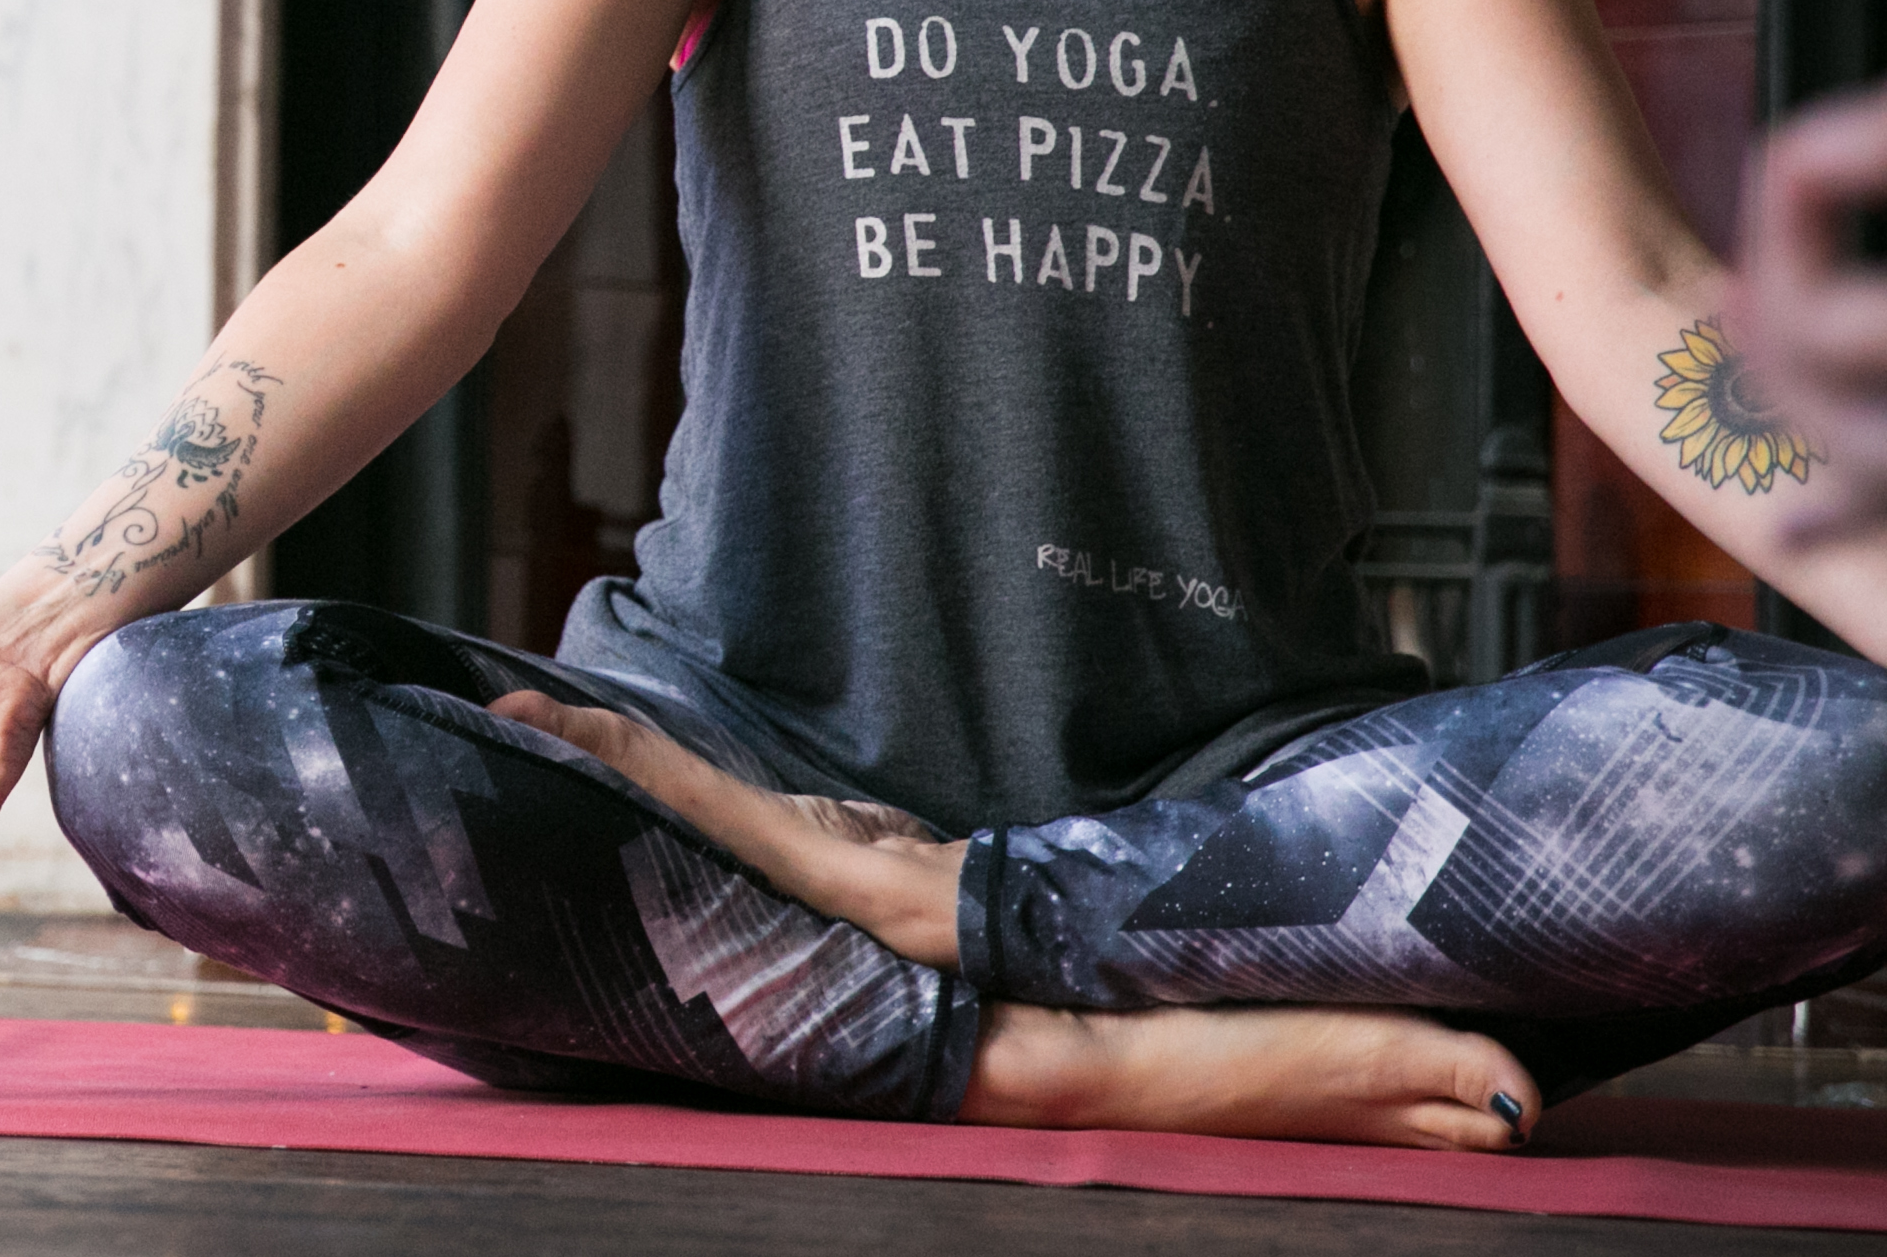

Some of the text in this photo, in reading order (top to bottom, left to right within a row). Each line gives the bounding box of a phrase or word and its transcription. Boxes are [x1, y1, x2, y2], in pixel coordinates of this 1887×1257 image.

[865, 15, 1218, 108] DO YOGA.
[838, 113, 976, 179] EAT
[855, 213, 942, 279] BE
[228, 360, 284, 386] with
[236, 379, 266, 429] your
[239, 433, 258, 466] one
[1036, 543, 1249, 622] REAL LIFE YOGA
